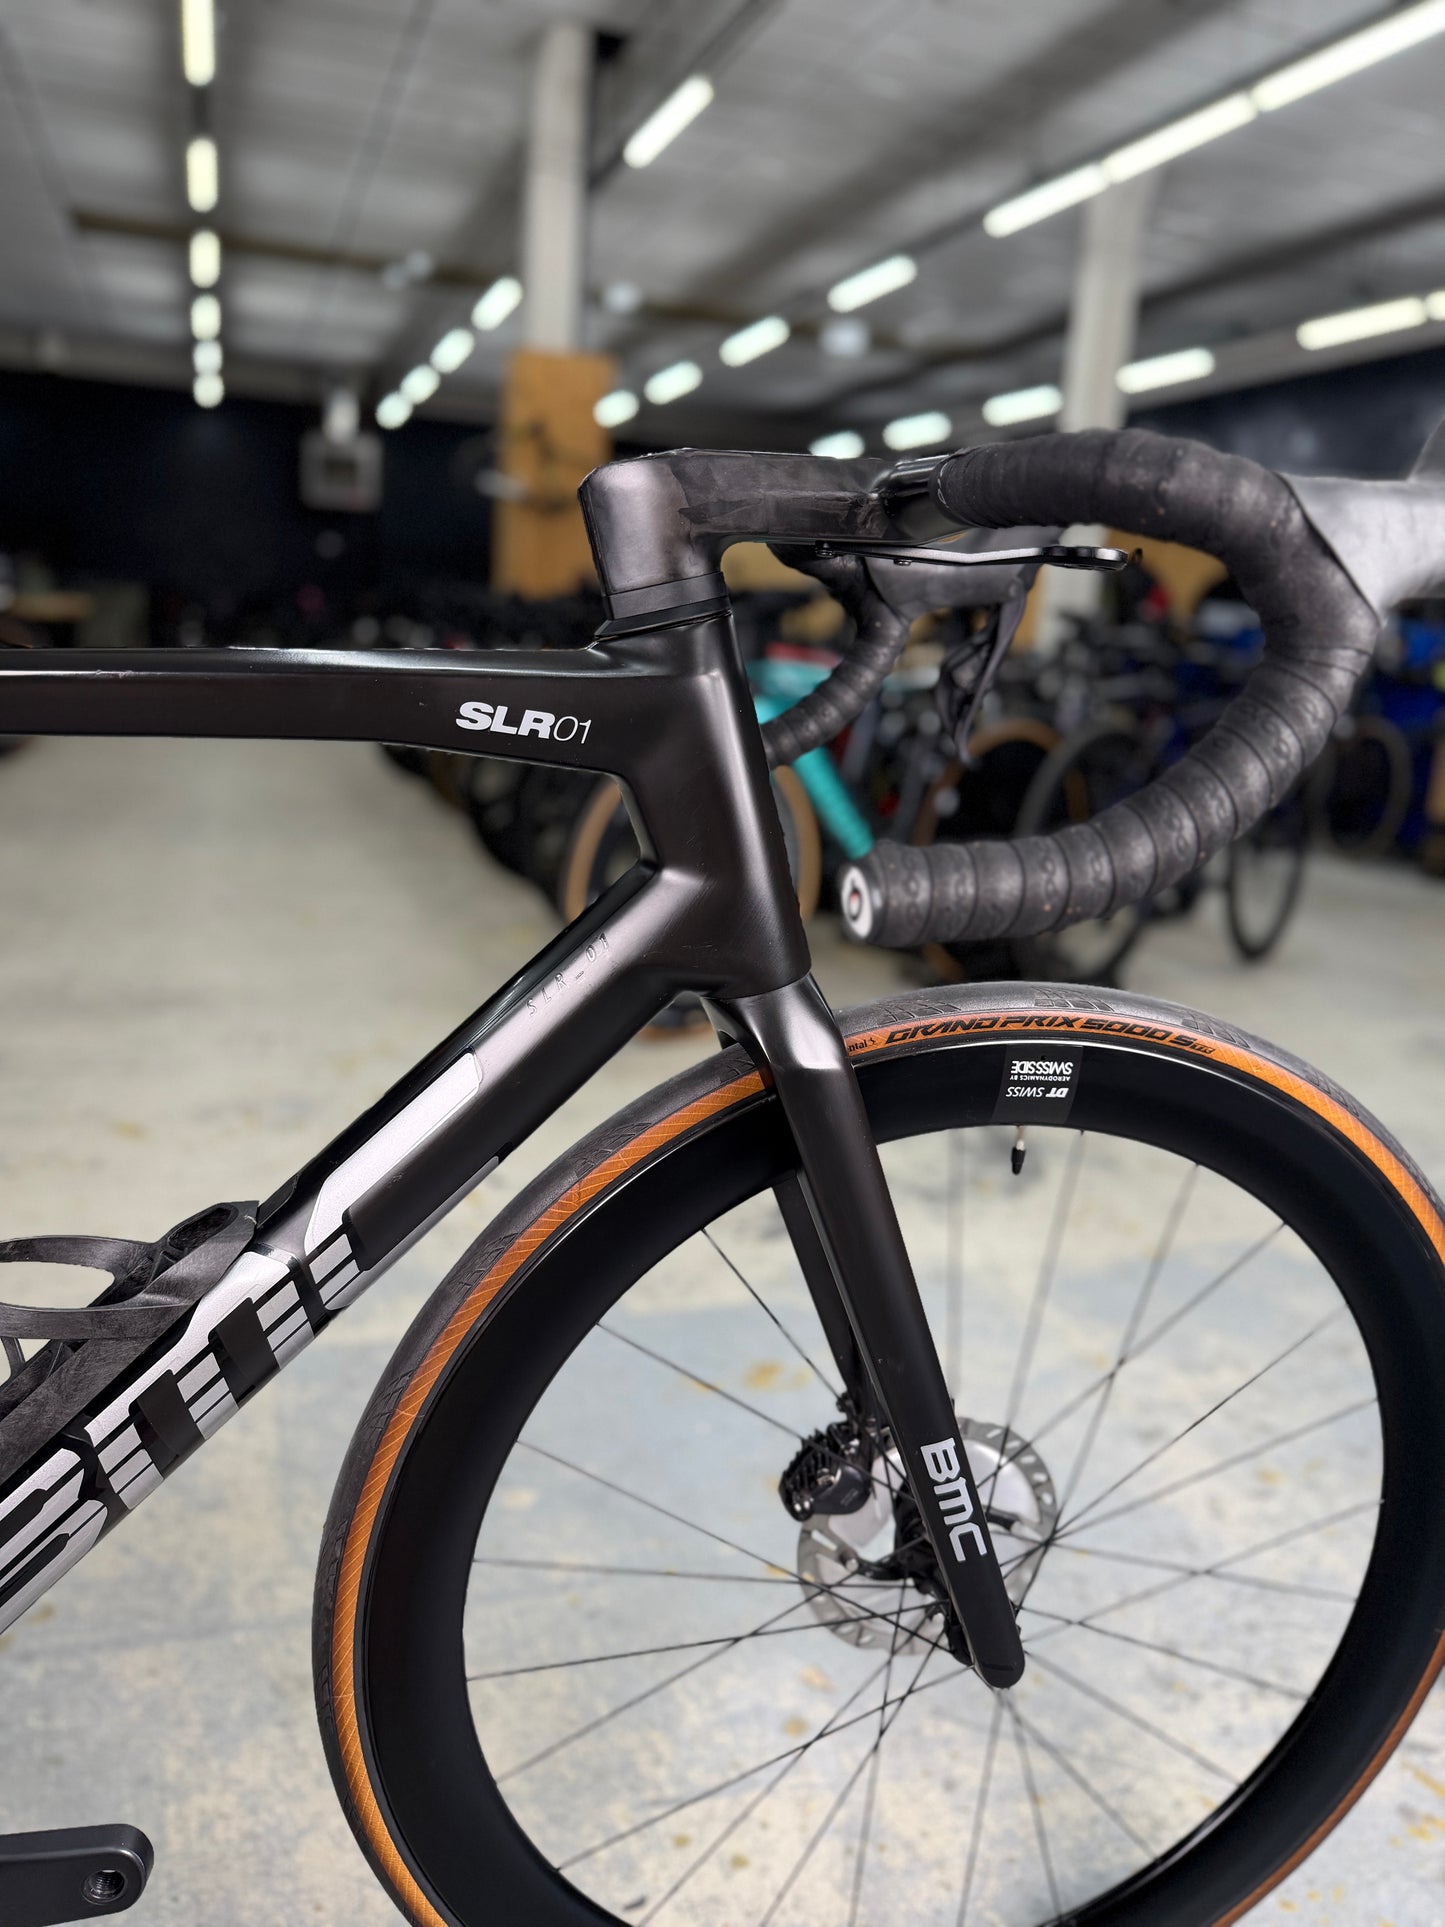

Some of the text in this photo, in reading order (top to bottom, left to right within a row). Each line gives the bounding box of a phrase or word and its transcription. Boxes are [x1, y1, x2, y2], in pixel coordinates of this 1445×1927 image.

[455, 701, 592, 744] SLR01
[885, 1016, 1001, 1045] GRAND
[1001, 1015, 1083, 1028] PRIX
[1081, 1018, 1174, 1041] 5000
[1168, 1034, 1198, 1047] S
[1005, 1086, 1069, 1098] DT SWISS
[920, 1437, 987, 1563] BMC
